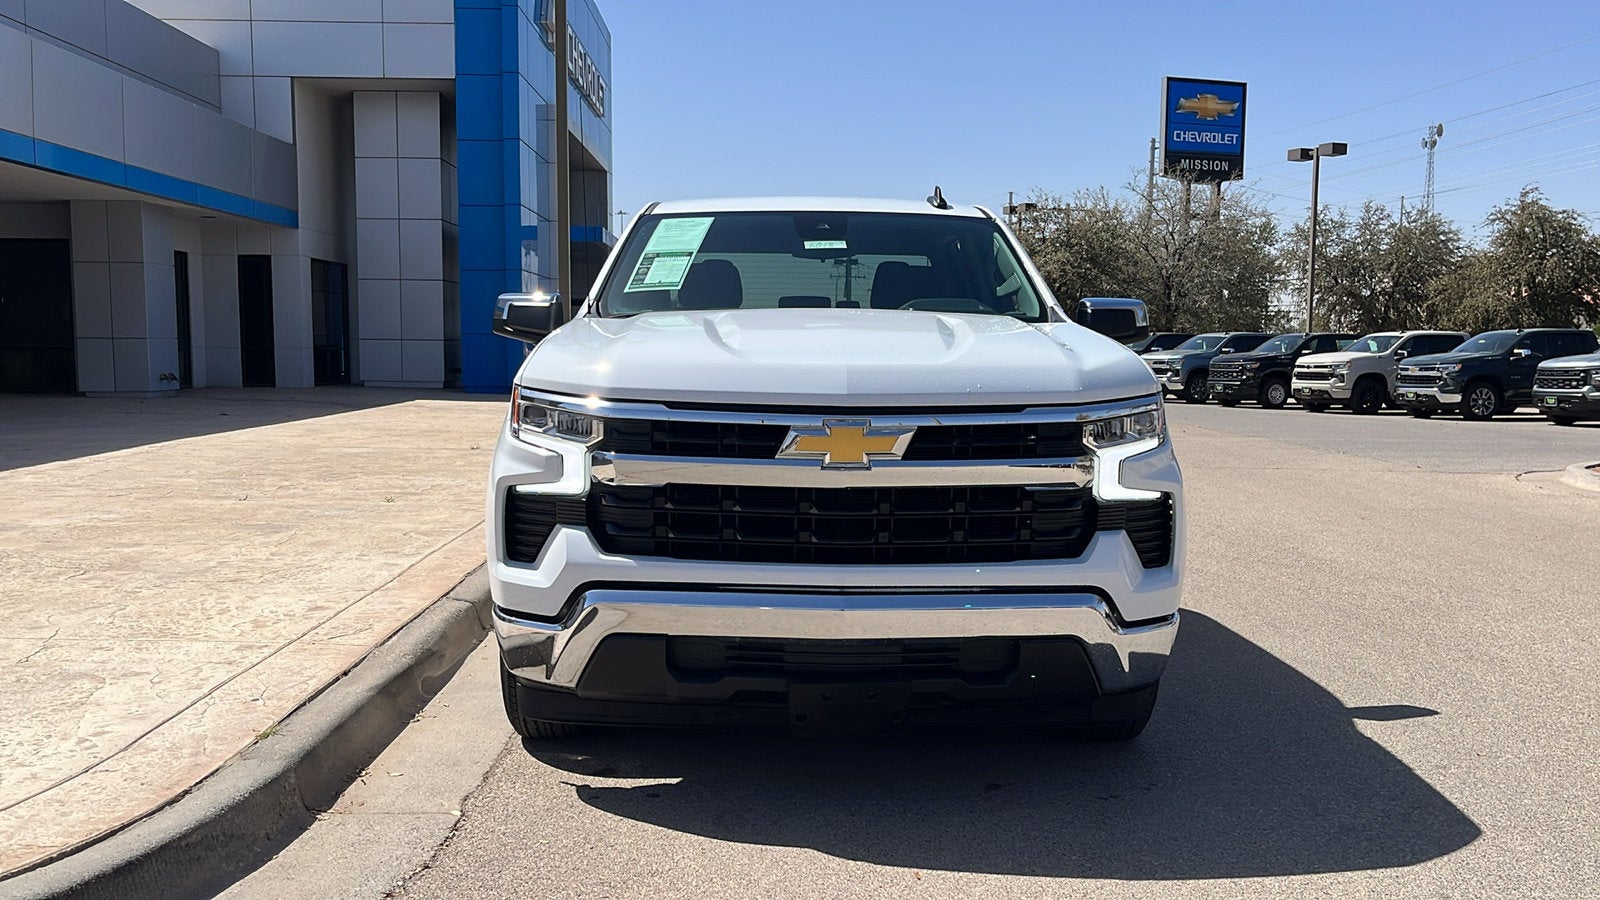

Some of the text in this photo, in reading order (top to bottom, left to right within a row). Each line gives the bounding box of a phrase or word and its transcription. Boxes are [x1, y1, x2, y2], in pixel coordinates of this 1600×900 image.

[567, 23, 605, 115] CHEVROLET
[1173, 130, 1239, 145] CHEVROLET
[1181, 158, 1229, 171] MISSION
